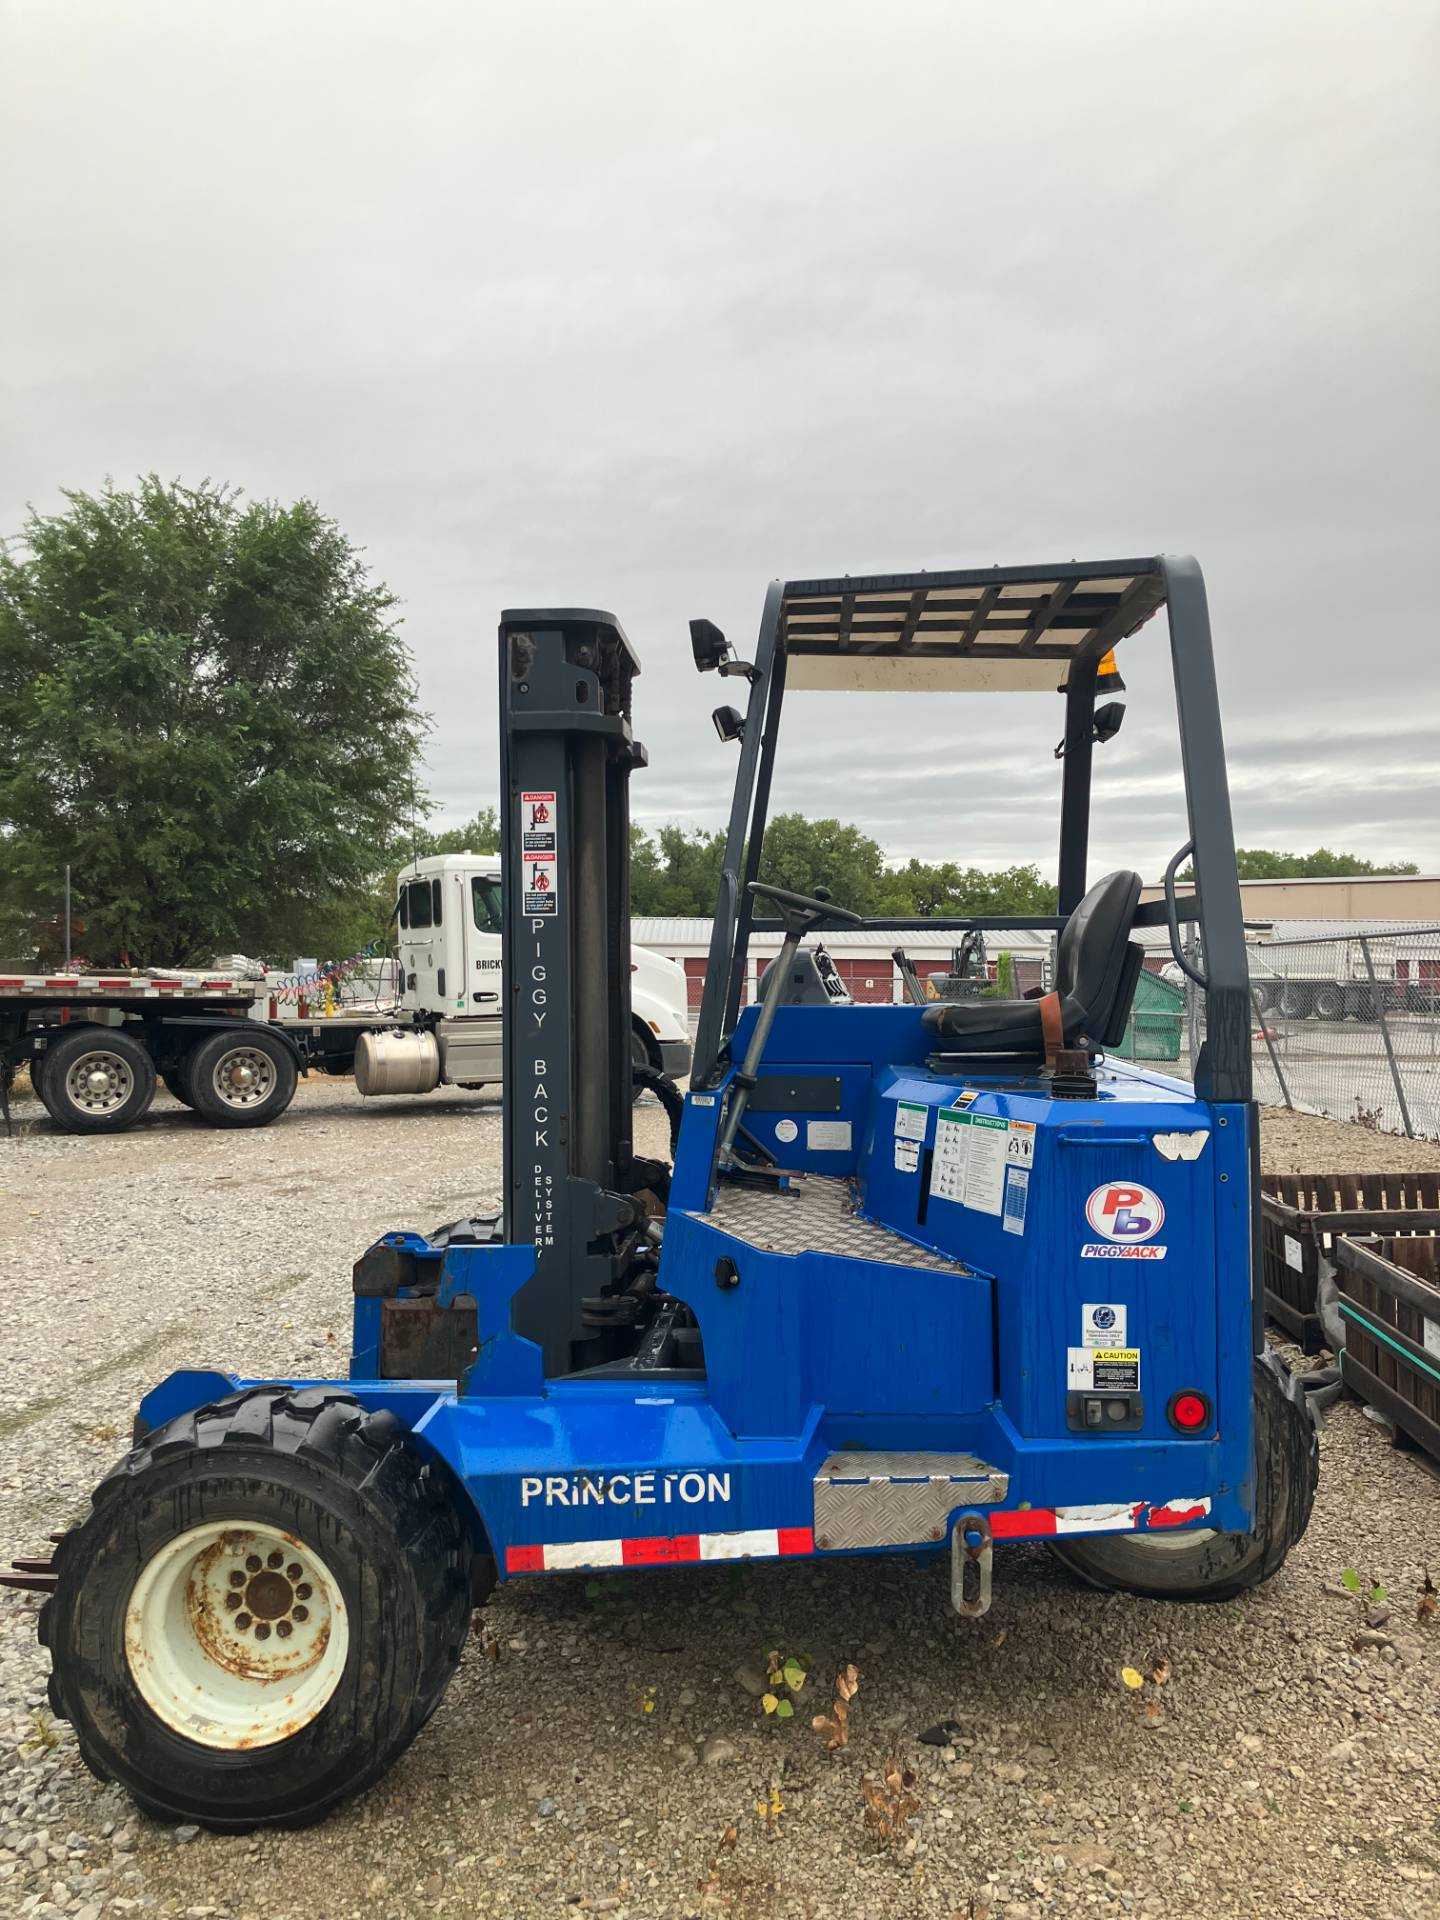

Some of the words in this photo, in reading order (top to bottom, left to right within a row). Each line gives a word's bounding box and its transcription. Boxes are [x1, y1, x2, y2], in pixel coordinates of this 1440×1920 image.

[531, 919, 547, 1028] PIGGY
[534, 1059, 549, 1147] BACK
[545, 1176, 554, 1246] SYSTEM
[1084, 1245, 1159, 1258] PIGGYBACK
[1103, 1352, 1138, 1360] CAUTION
[521, 1472, 731, 1507] PRINCETON
